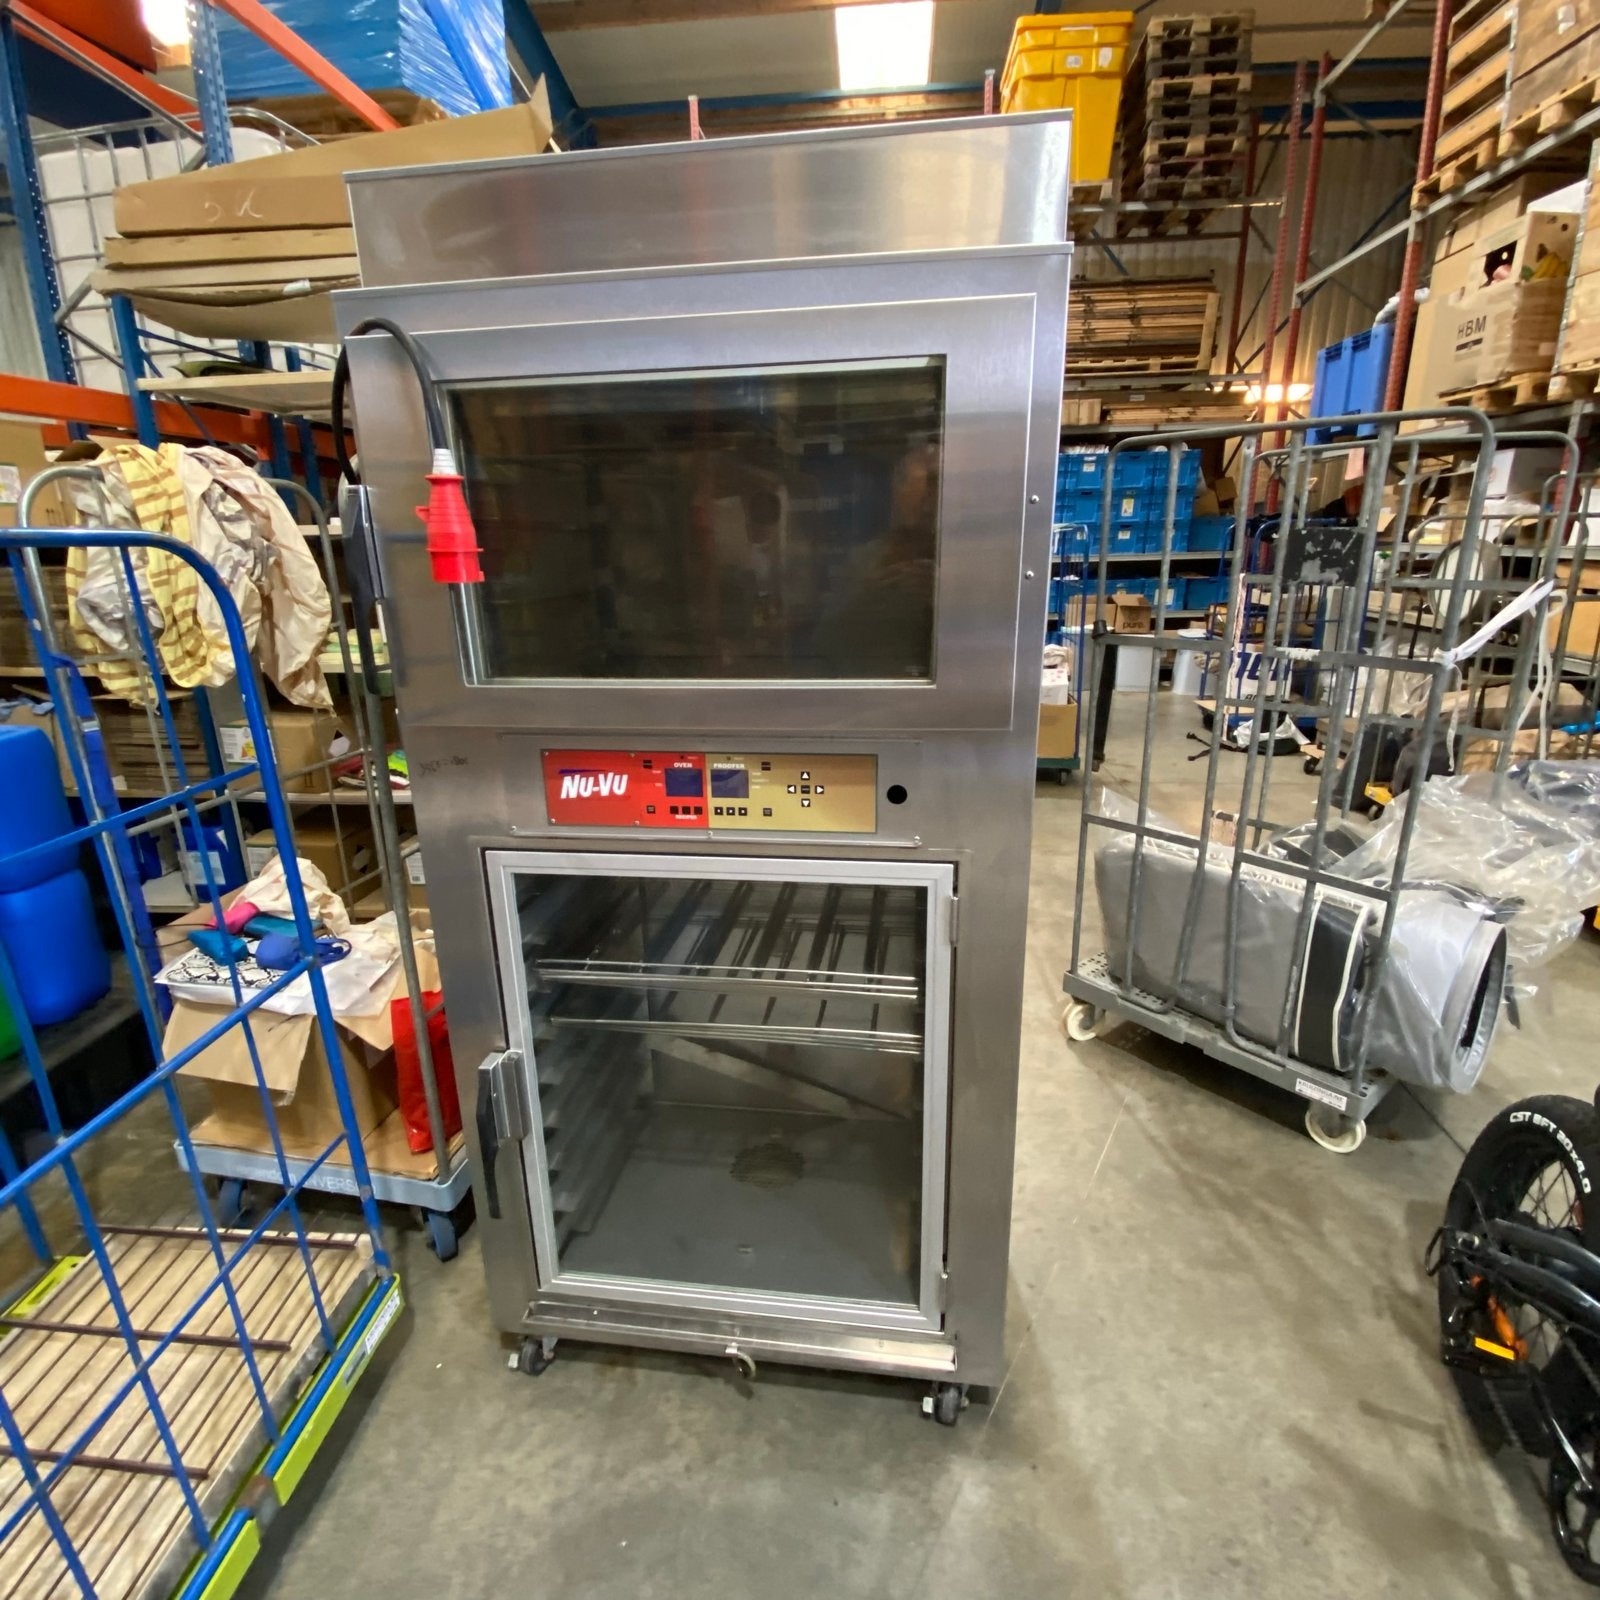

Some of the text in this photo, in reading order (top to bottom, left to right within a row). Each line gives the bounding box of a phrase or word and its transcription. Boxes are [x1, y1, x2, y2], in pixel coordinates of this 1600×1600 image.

[1458, 315, 1486, 338] HBM
[1509, 1111, 1532, 1123] CST
[1532, 1113, 1557, 1133] BFT
